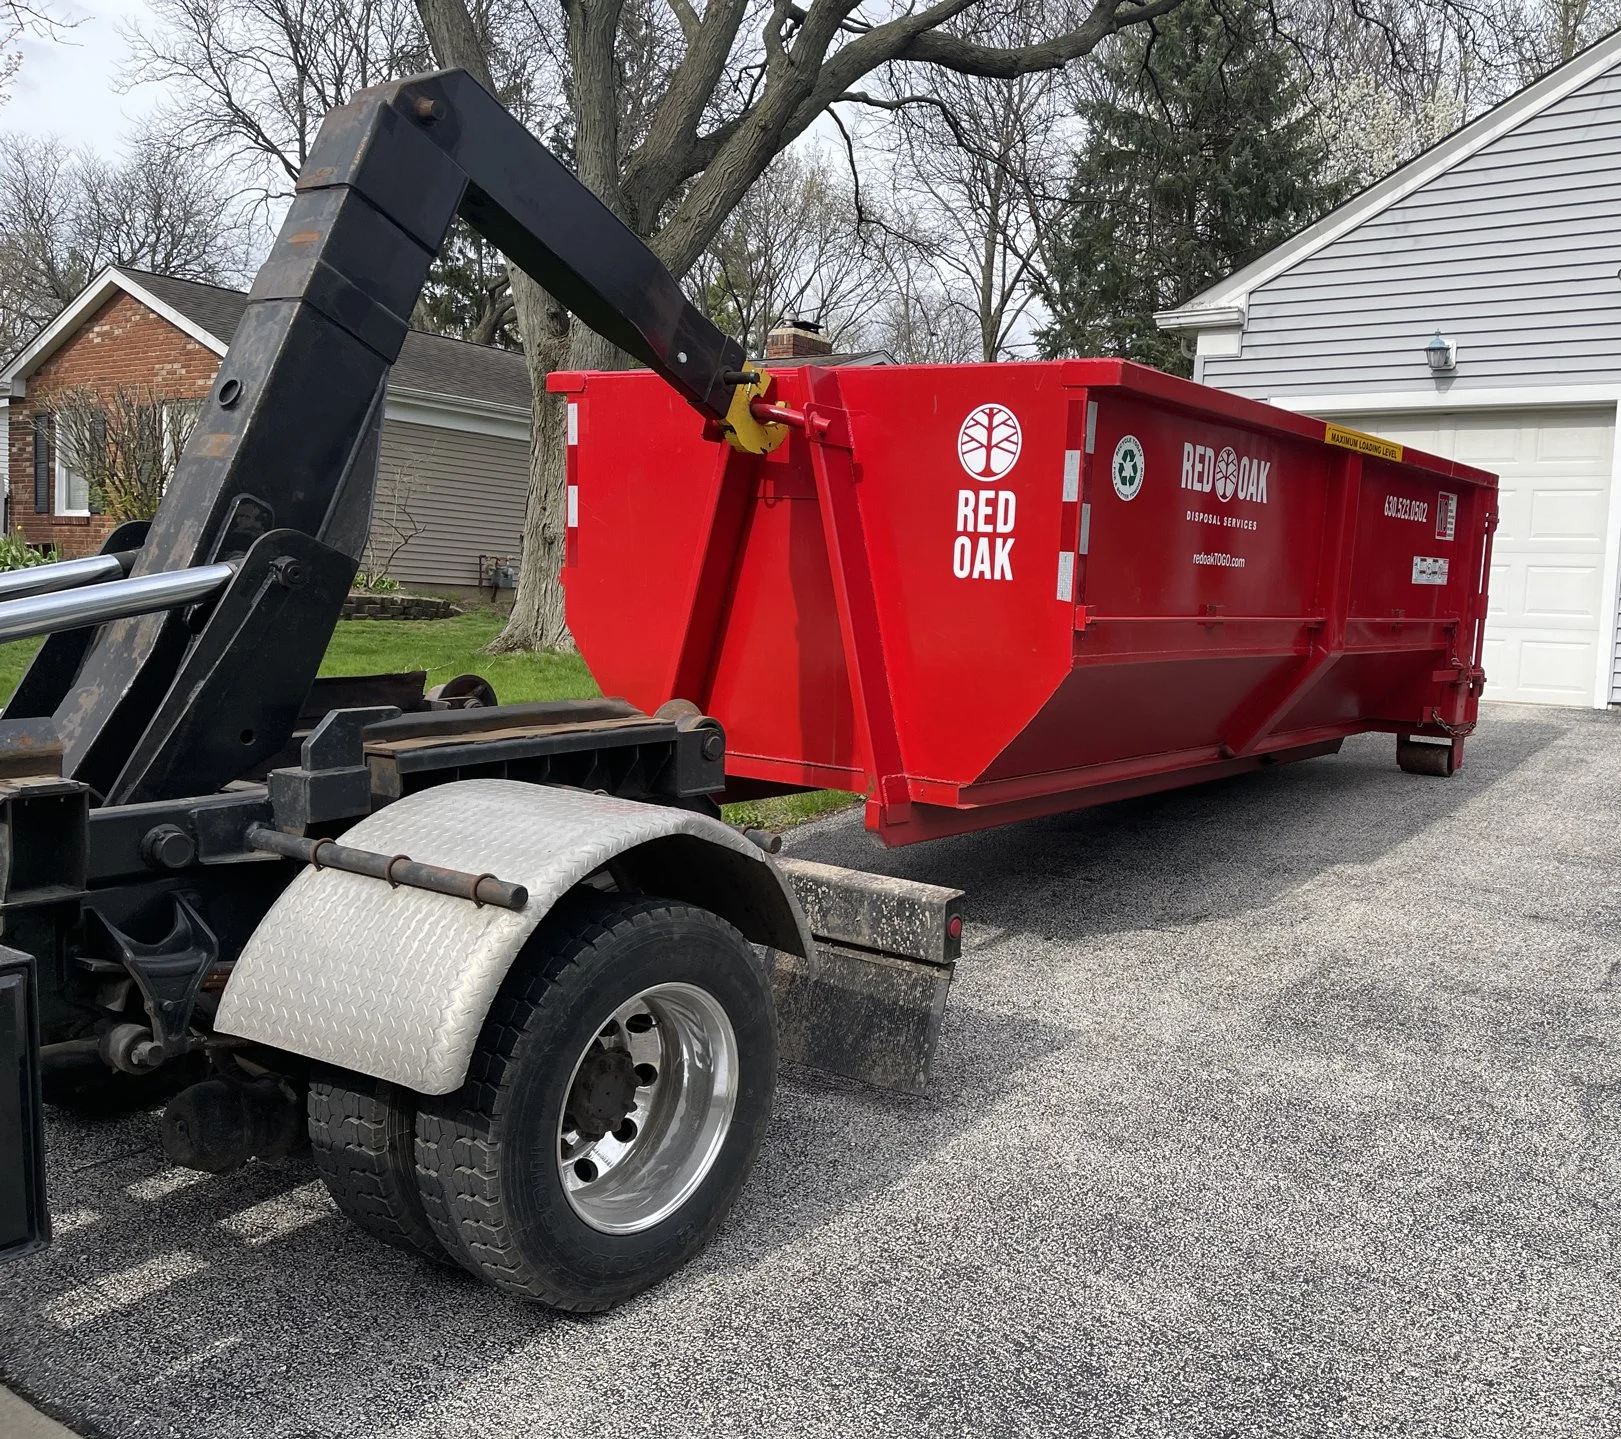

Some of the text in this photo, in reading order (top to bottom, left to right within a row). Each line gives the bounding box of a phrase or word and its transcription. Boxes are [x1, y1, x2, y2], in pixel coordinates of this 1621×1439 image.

[1331, 433, 1397, 459] MAXIMUM LOADING LEVEL
[1181, 442, 1271, 504] RED OAK
[956, 489, 1017, 534] RED
[1186, 510, 1257, 531] DISPOSAL SERVICES
[1384, 495, 1428, 523] 630.523.0502
[953, 535, 1016, 581] OAK
[1192, 551, 1245, 568] redoakTOGO.com
